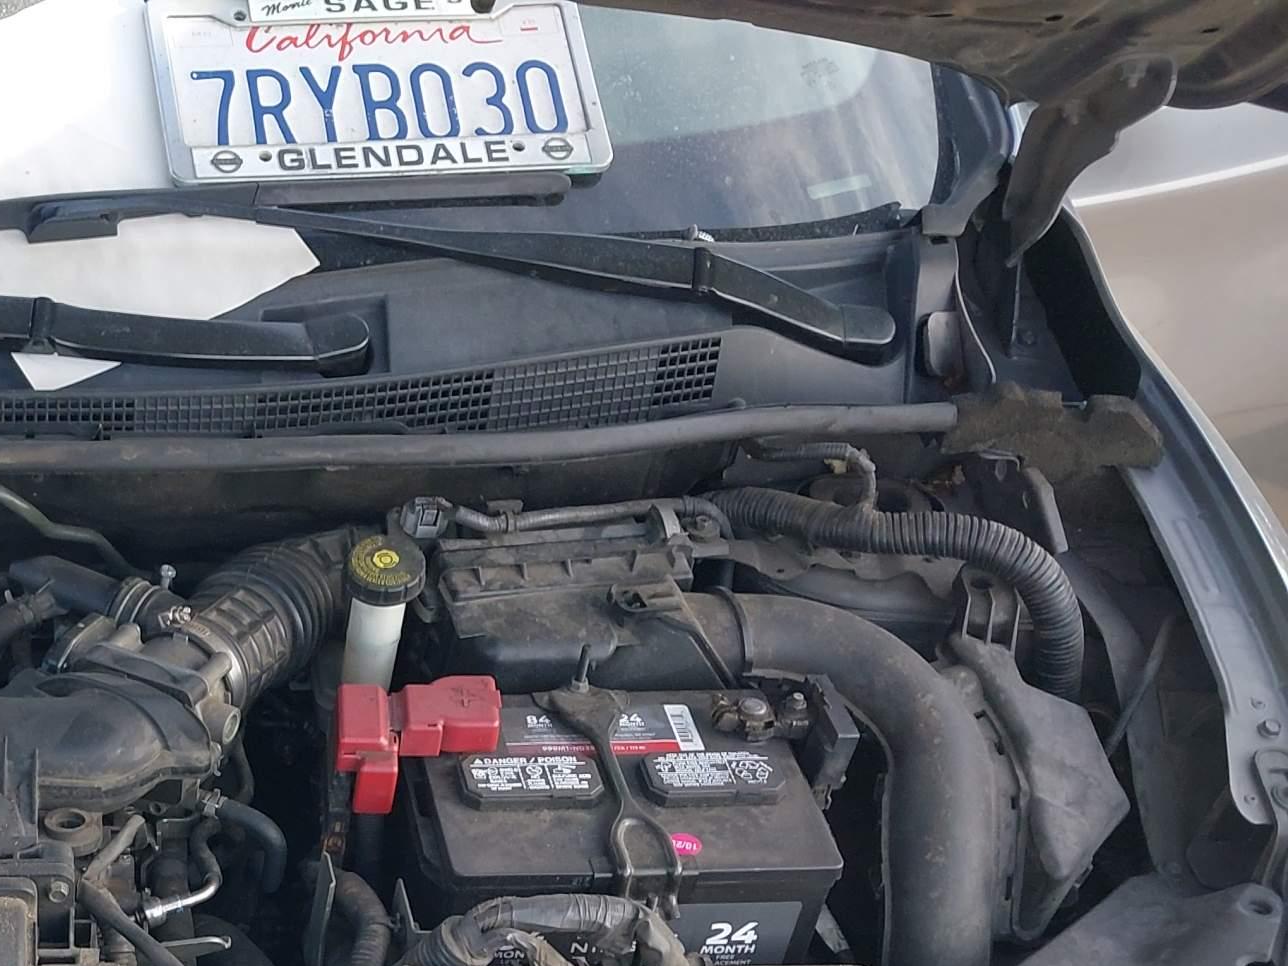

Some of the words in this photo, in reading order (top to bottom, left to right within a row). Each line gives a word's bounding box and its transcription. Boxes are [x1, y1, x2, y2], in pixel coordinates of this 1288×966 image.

[245, 23, 503, 62] California
[190, 59, 569, 146] 7RYB030
[277, 140, 510, 171] GLENDALE
[526, 715, 551, 724] 84
[619, 713, 642, 722] 24
[483, 757, 527, 765] DANGER
[537, 756, 577, 764] POISON
[705, 921, 759, 945] 24
[700, 944, 756, 954] MONTH
[494, 950, 525, 959] MON
